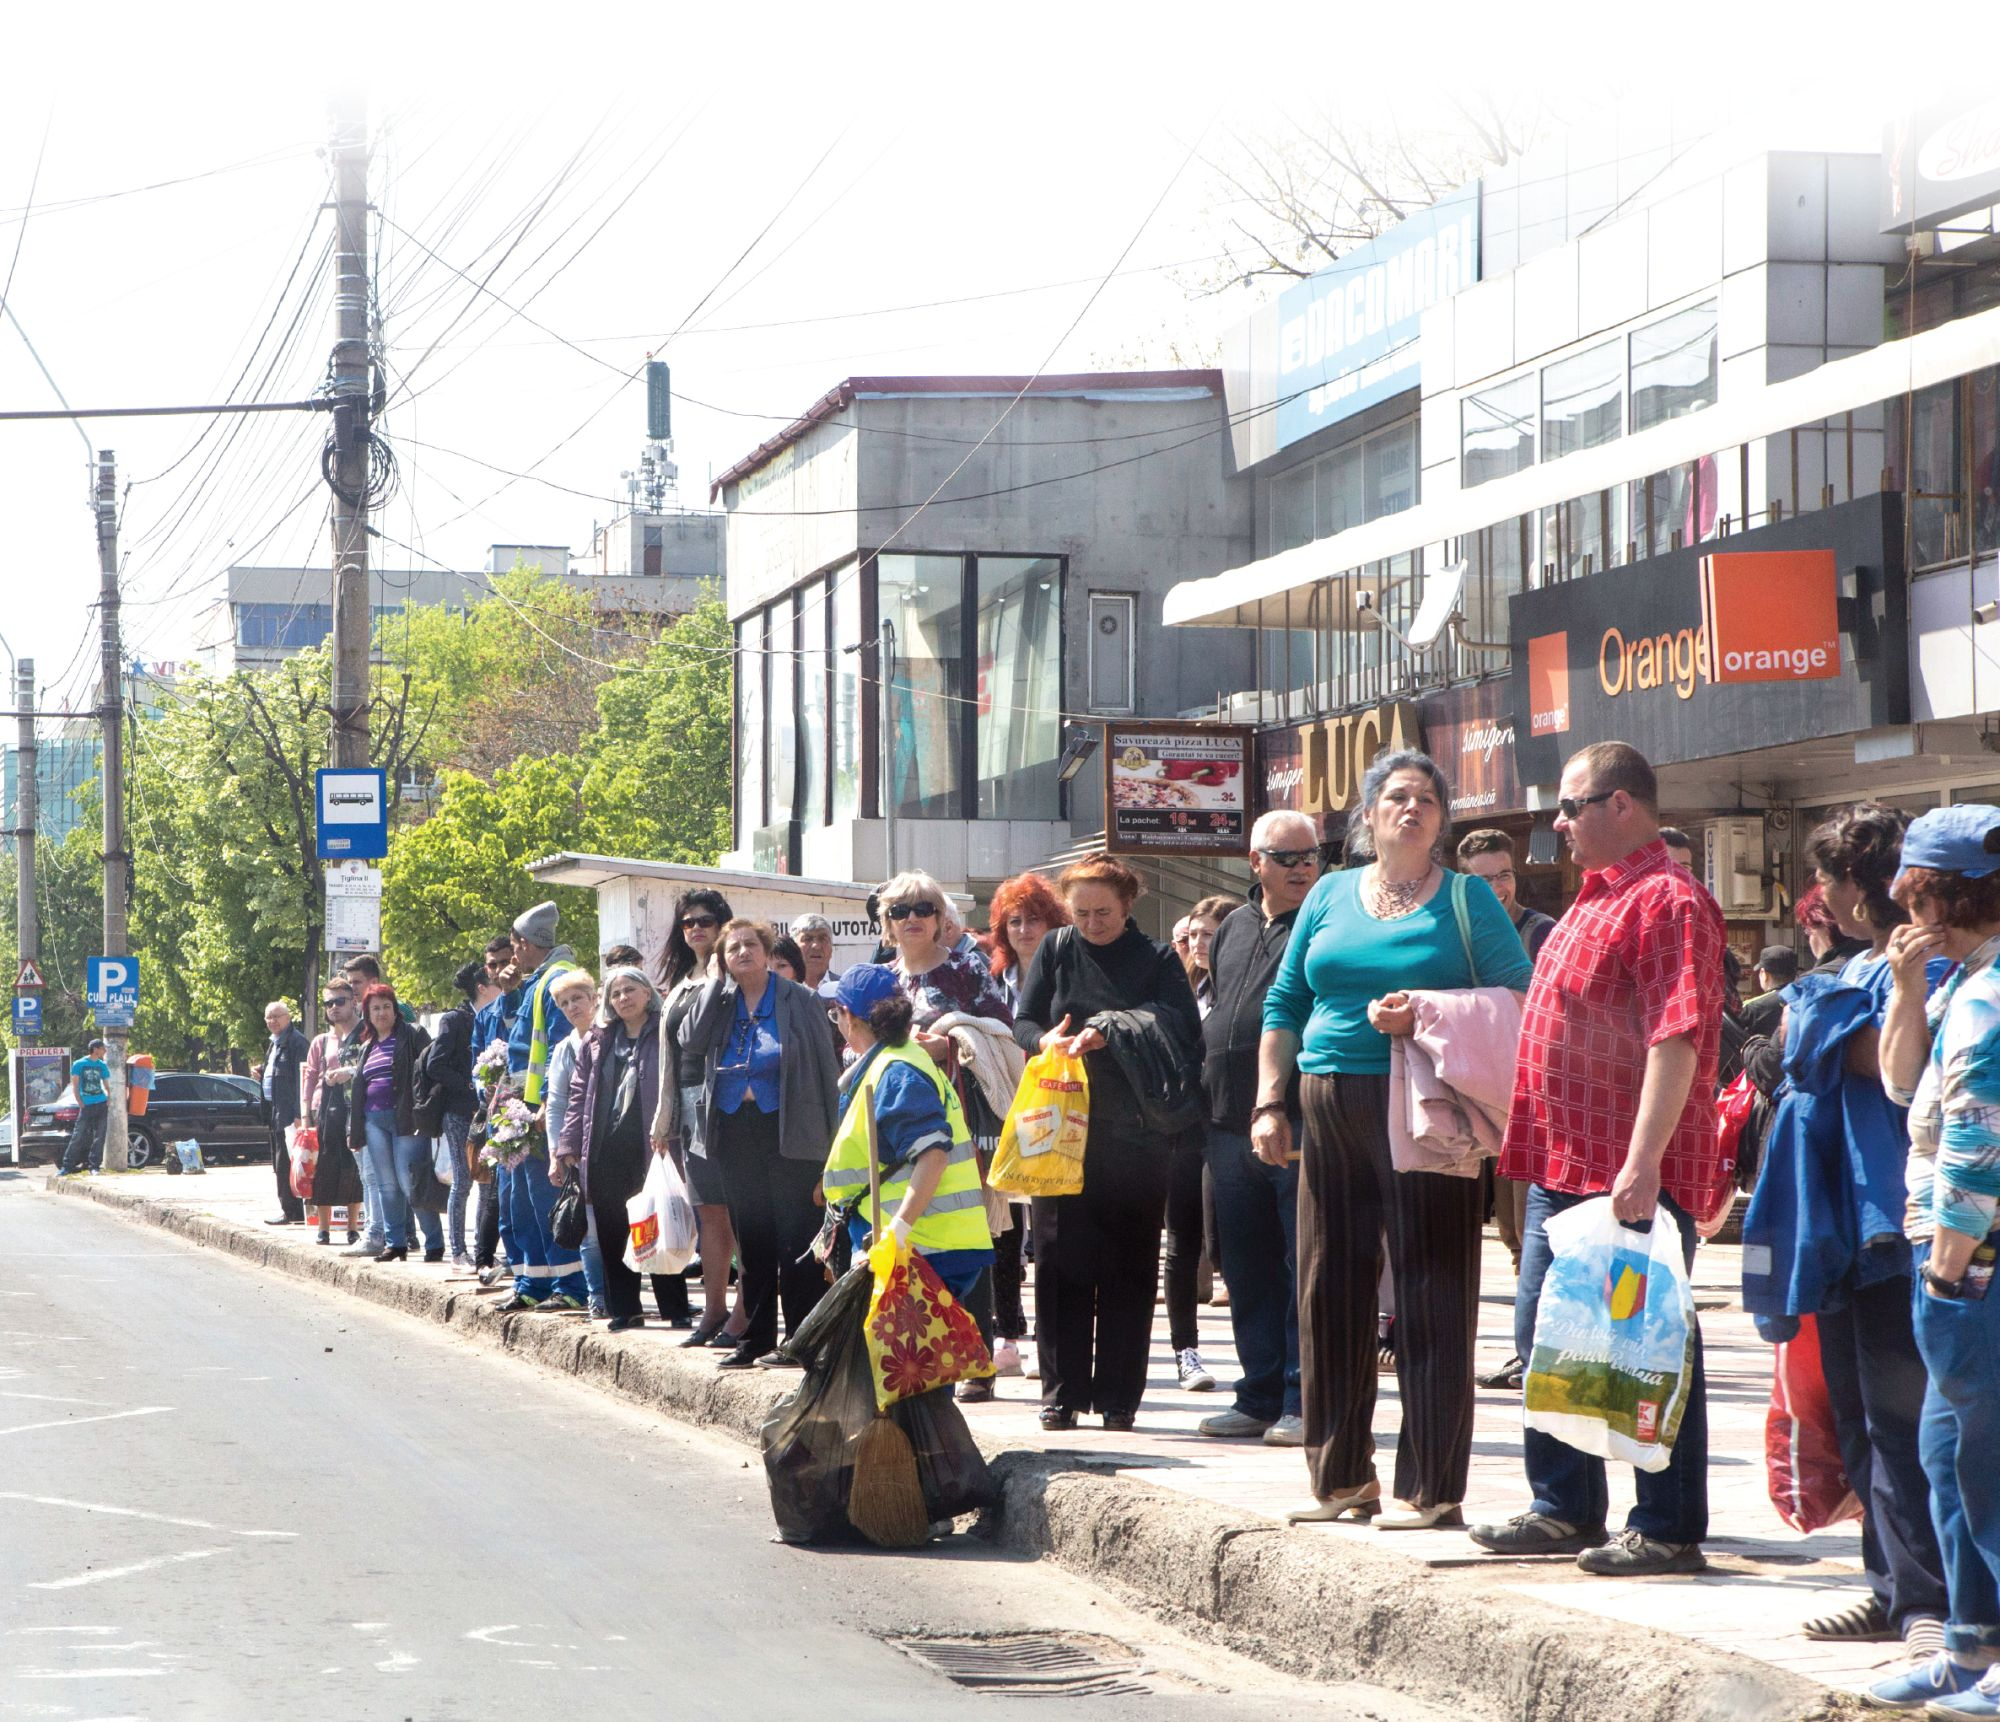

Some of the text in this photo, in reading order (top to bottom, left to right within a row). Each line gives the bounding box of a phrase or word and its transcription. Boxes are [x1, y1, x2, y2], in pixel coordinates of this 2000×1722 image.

[1724, 646, 1828, 676] orange
[1532, 705, 1567, 729] orange
[1174, 737, 1202, 748] pizza
[1205, 737, 1241, 747] LUCA
[1461, 719, 1515, 763] simigeri
[1119, 815, 1131, 824] La
[1209, 812, 1228, 827] 24
[832, 920, 882, 936] UTOTA
[98, 961, 128, 1003] P
[18, 997, 37, 1018] P
[20, 1047, 65, 1056] PREMIERA
